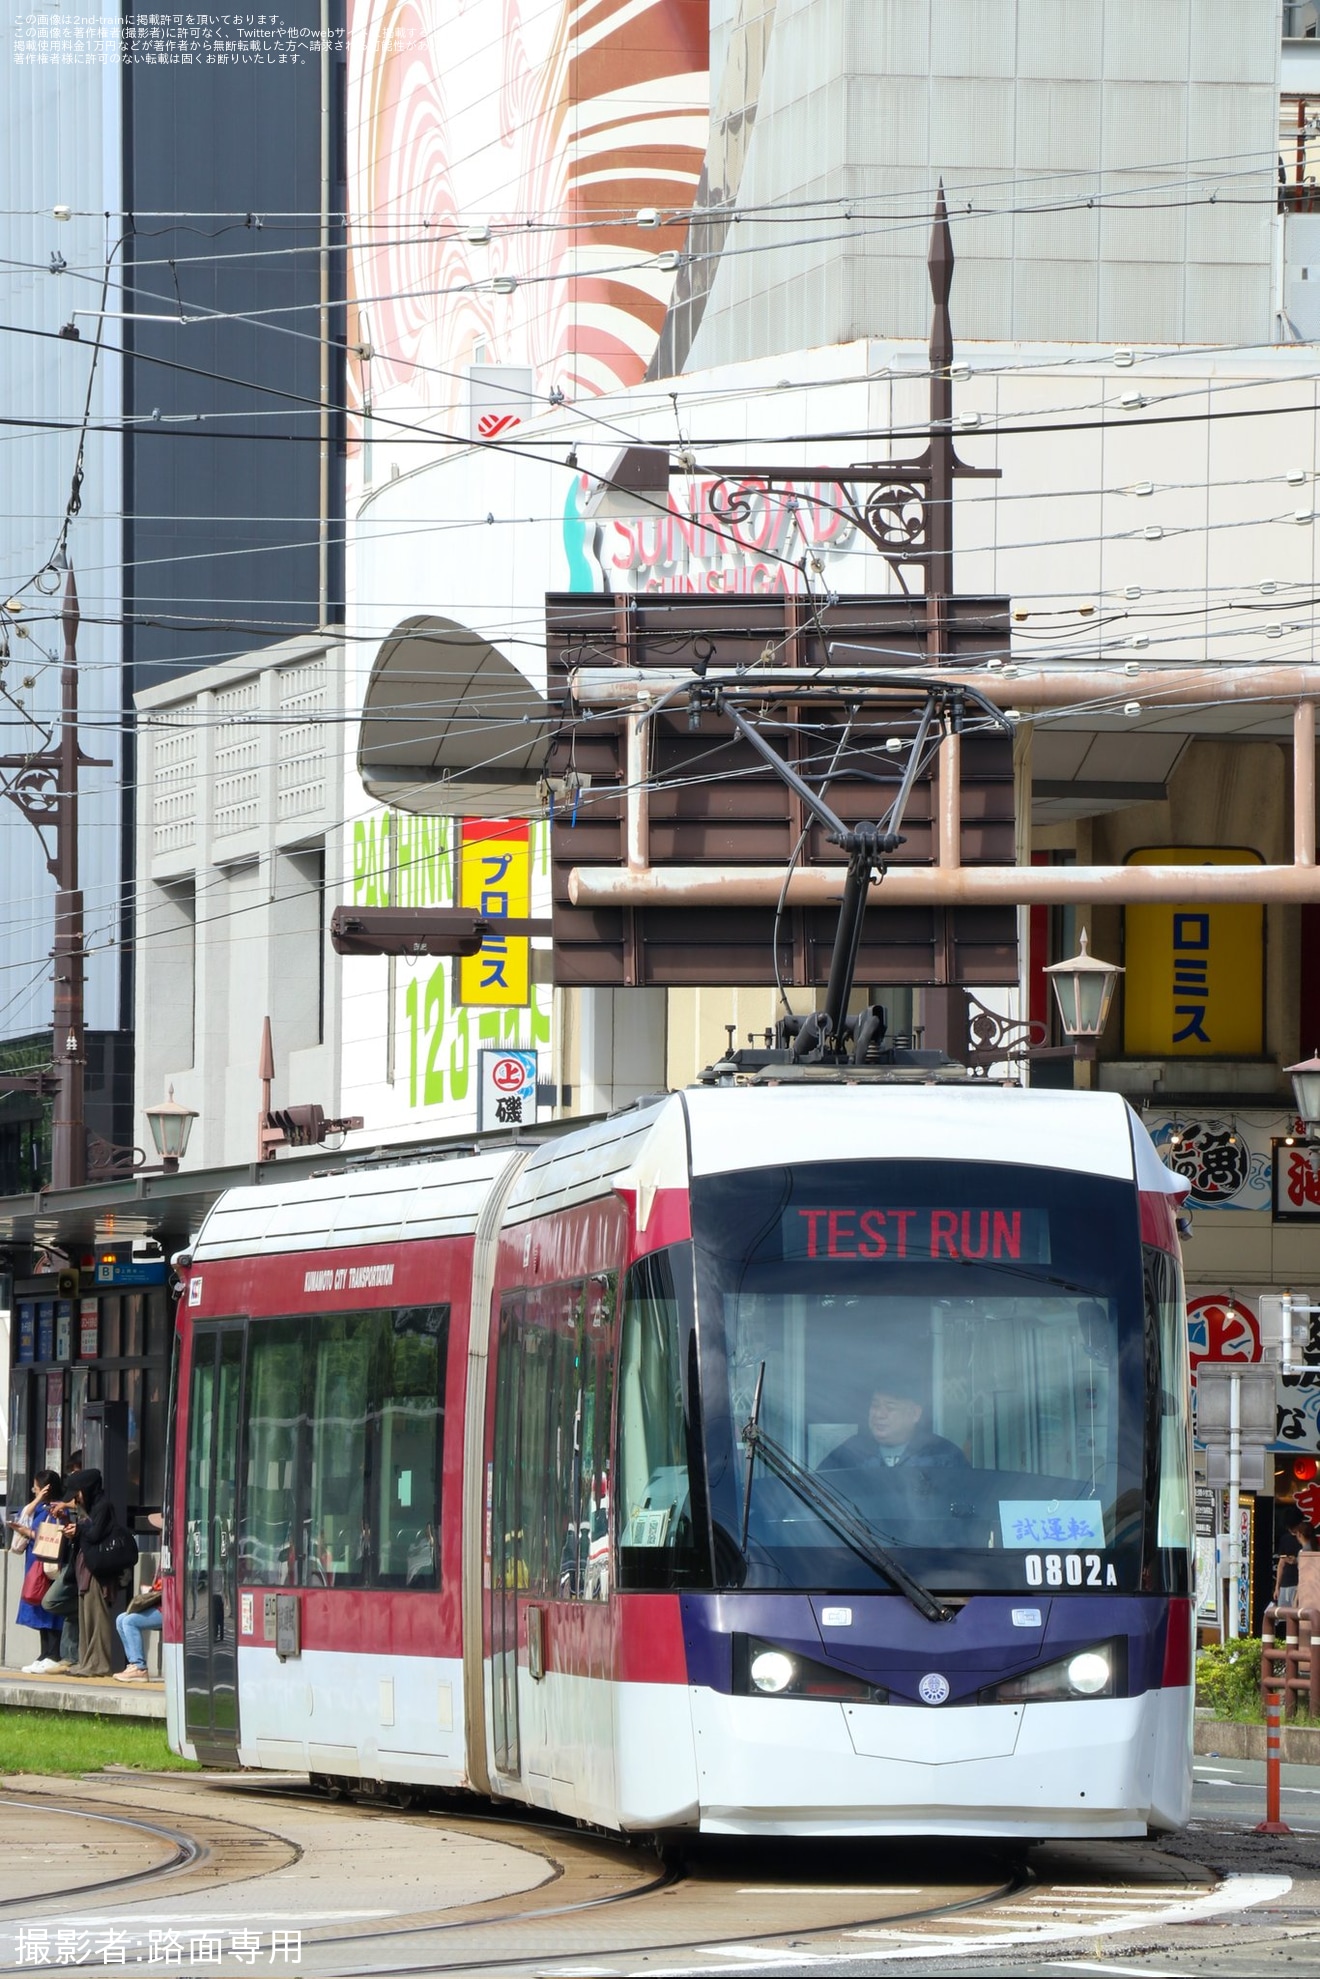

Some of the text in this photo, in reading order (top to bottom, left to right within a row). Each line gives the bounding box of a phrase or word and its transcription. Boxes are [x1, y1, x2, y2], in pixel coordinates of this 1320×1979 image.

[612, 466, 844, 570] SUNROAD
[480, 854, 513, 987] プロミス
[1172, 863, 1212, 1043] ロミス
[798, 1210, 1021, 1259] TEST RUN
[334, 1268, 348, 1290] CITY
[1011, 1516, 1096, 1543] 試運転
